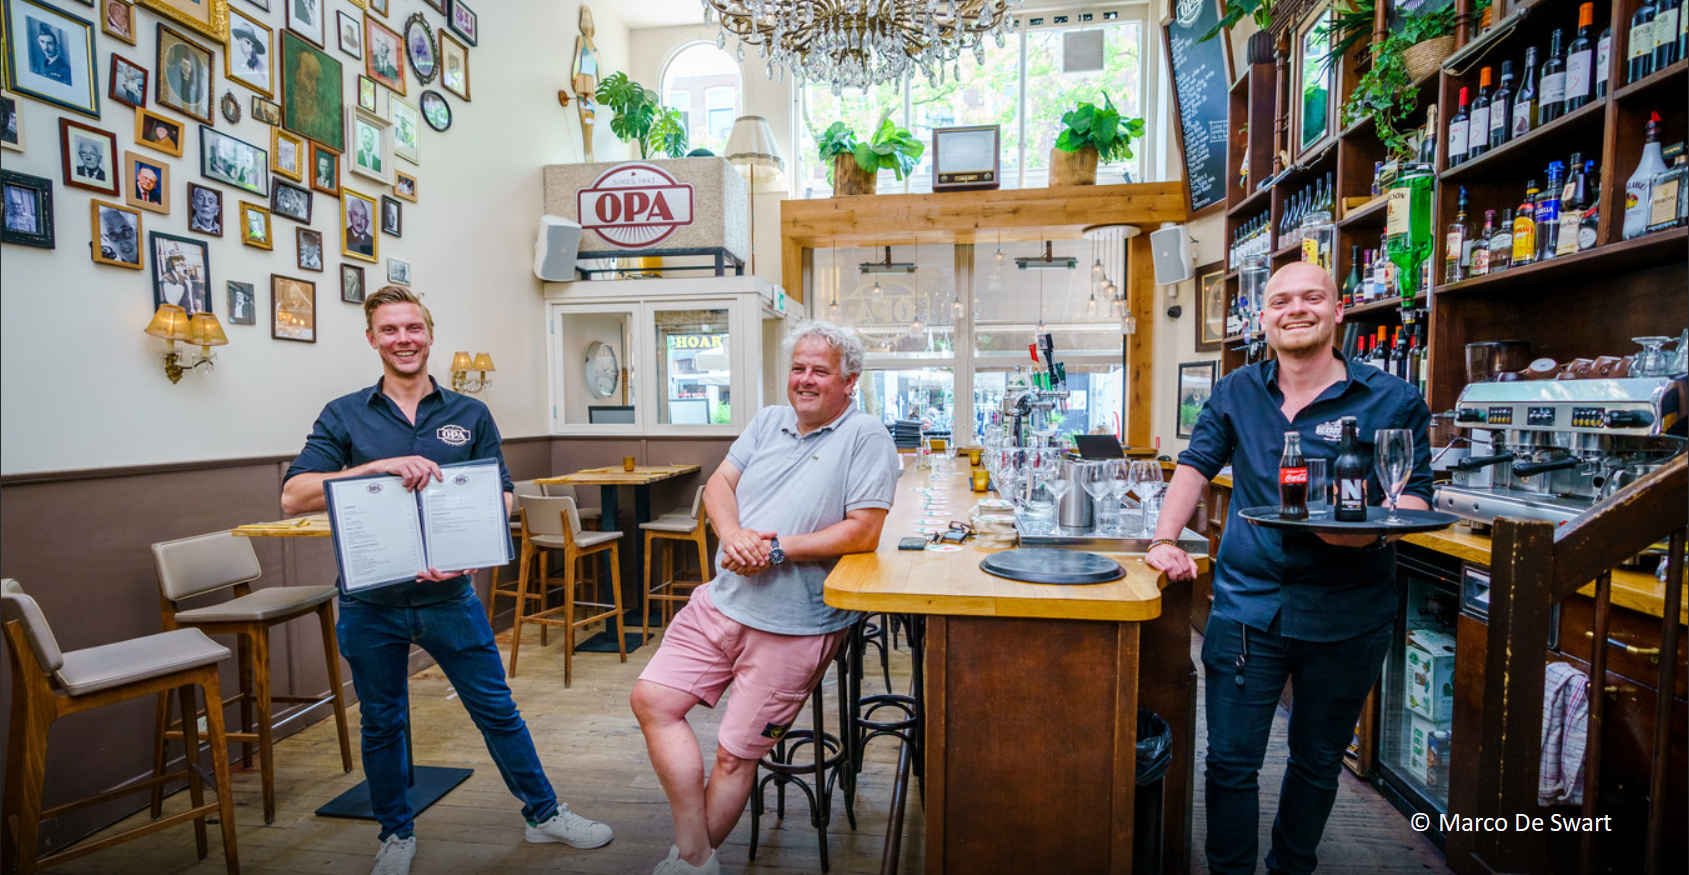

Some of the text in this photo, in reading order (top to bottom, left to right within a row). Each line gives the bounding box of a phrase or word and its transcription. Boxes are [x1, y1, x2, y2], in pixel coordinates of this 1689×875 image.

[613, 178, 635, 186] SINDS
[595, 191, 675, 223] OPA
[442, 429, 467, 440] OPA
[1284, 474, 1307, 482] Coca-Cola
[1341, 478, 1362, 499] N
